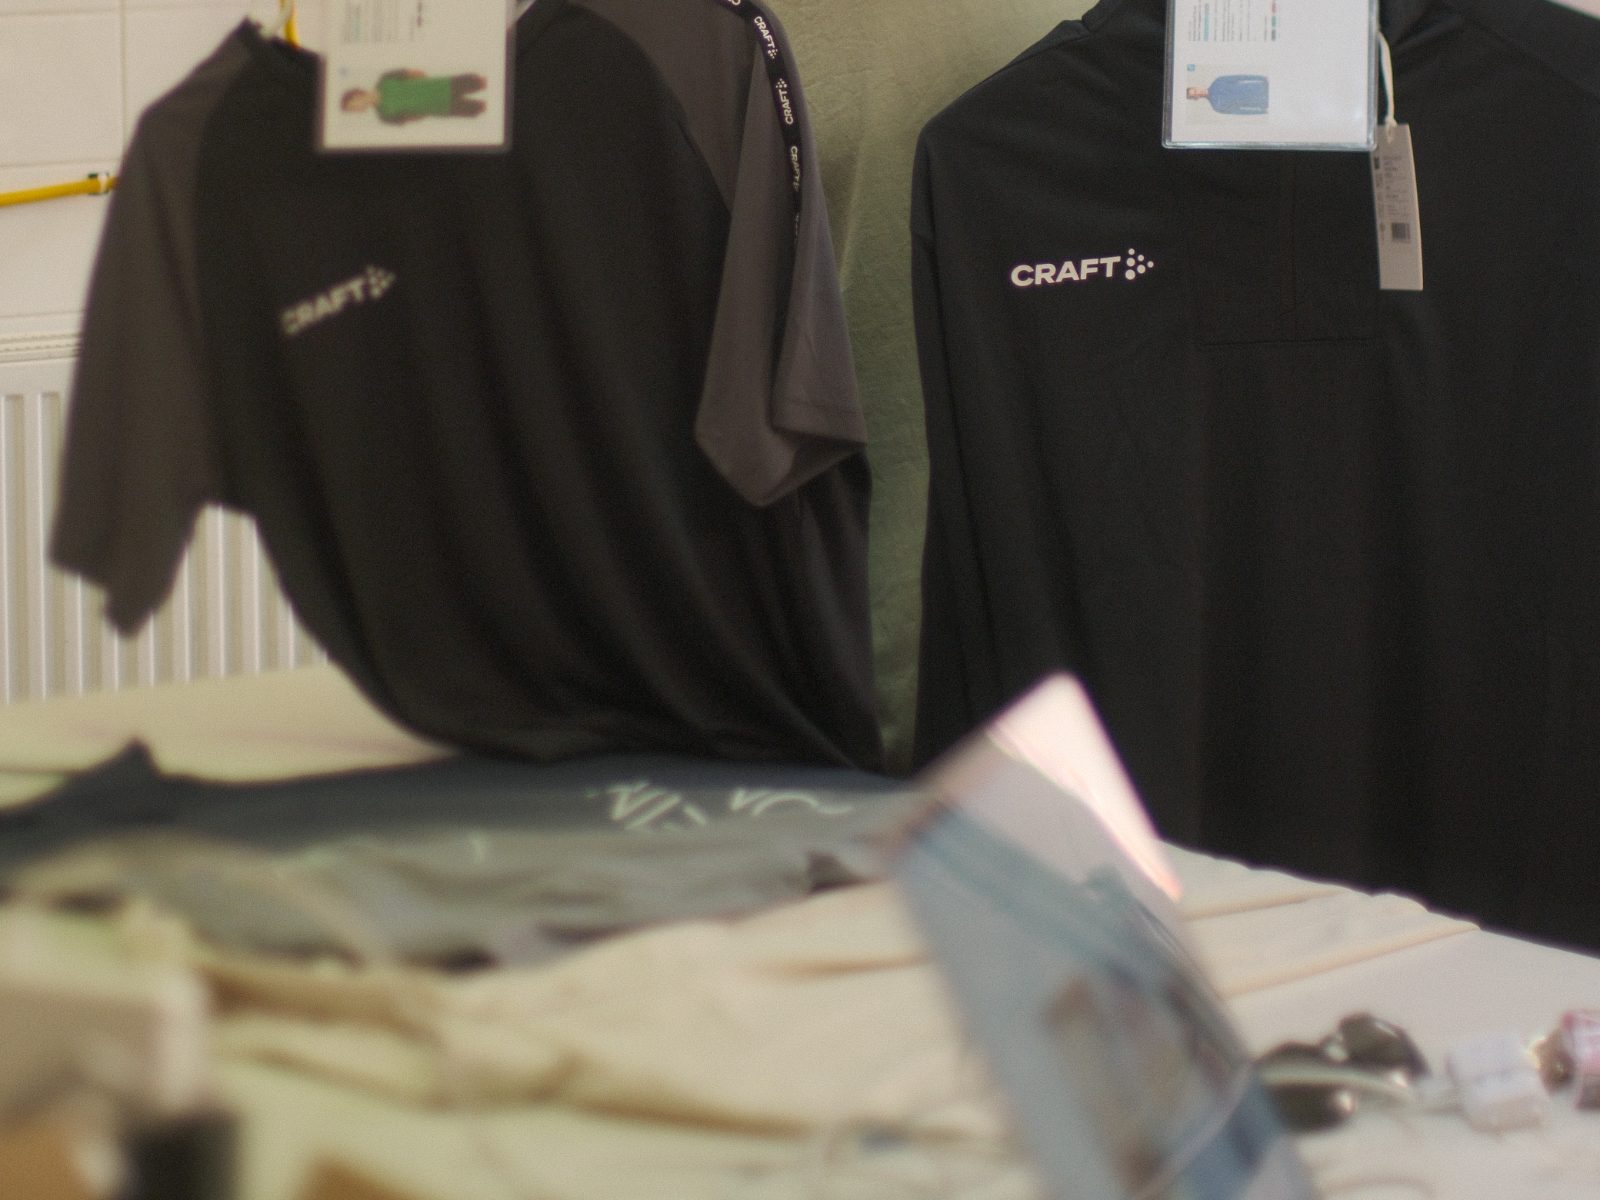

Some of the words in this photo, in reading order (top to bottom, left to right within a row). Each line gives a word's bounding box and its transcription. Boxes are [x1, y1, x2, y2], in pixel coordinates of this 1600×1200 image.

[754, 16, 776, 49] CRAFT
[779, 89, 794, 125] CRAFT
[1011, 256, 1122, 287] CRAFT
